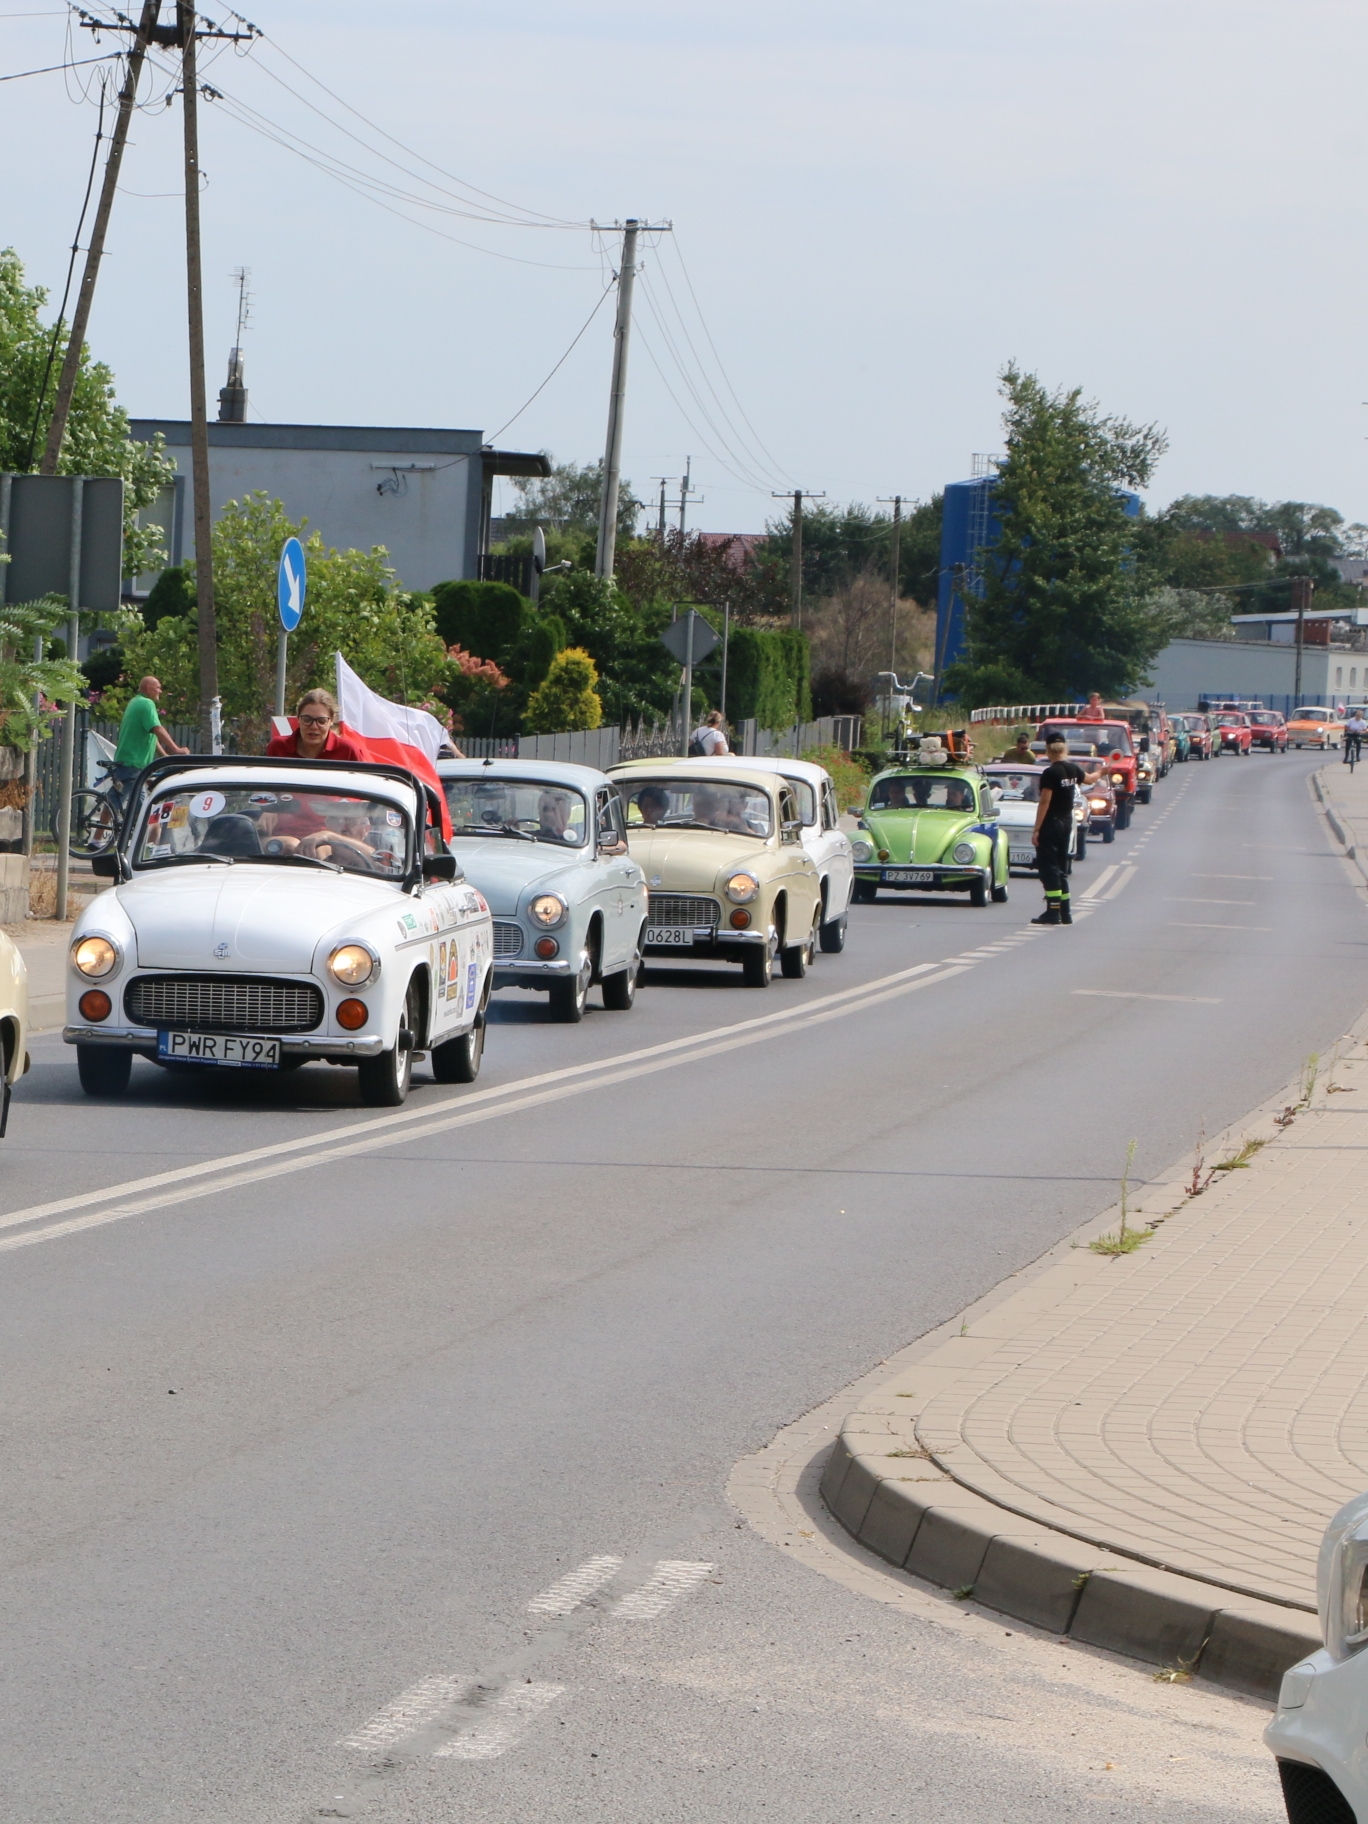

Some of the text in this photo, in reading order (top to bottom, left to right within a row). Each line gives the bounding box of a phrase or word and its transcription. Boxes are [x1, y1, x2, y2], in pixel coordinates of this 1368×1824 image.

[202, 796, 214, 811] 9
[887, 871, 931, 881] PZ 3V769
[647, 930, 691, 943] 0628L
[172, 1033, 277, 1063] PWR FY94
